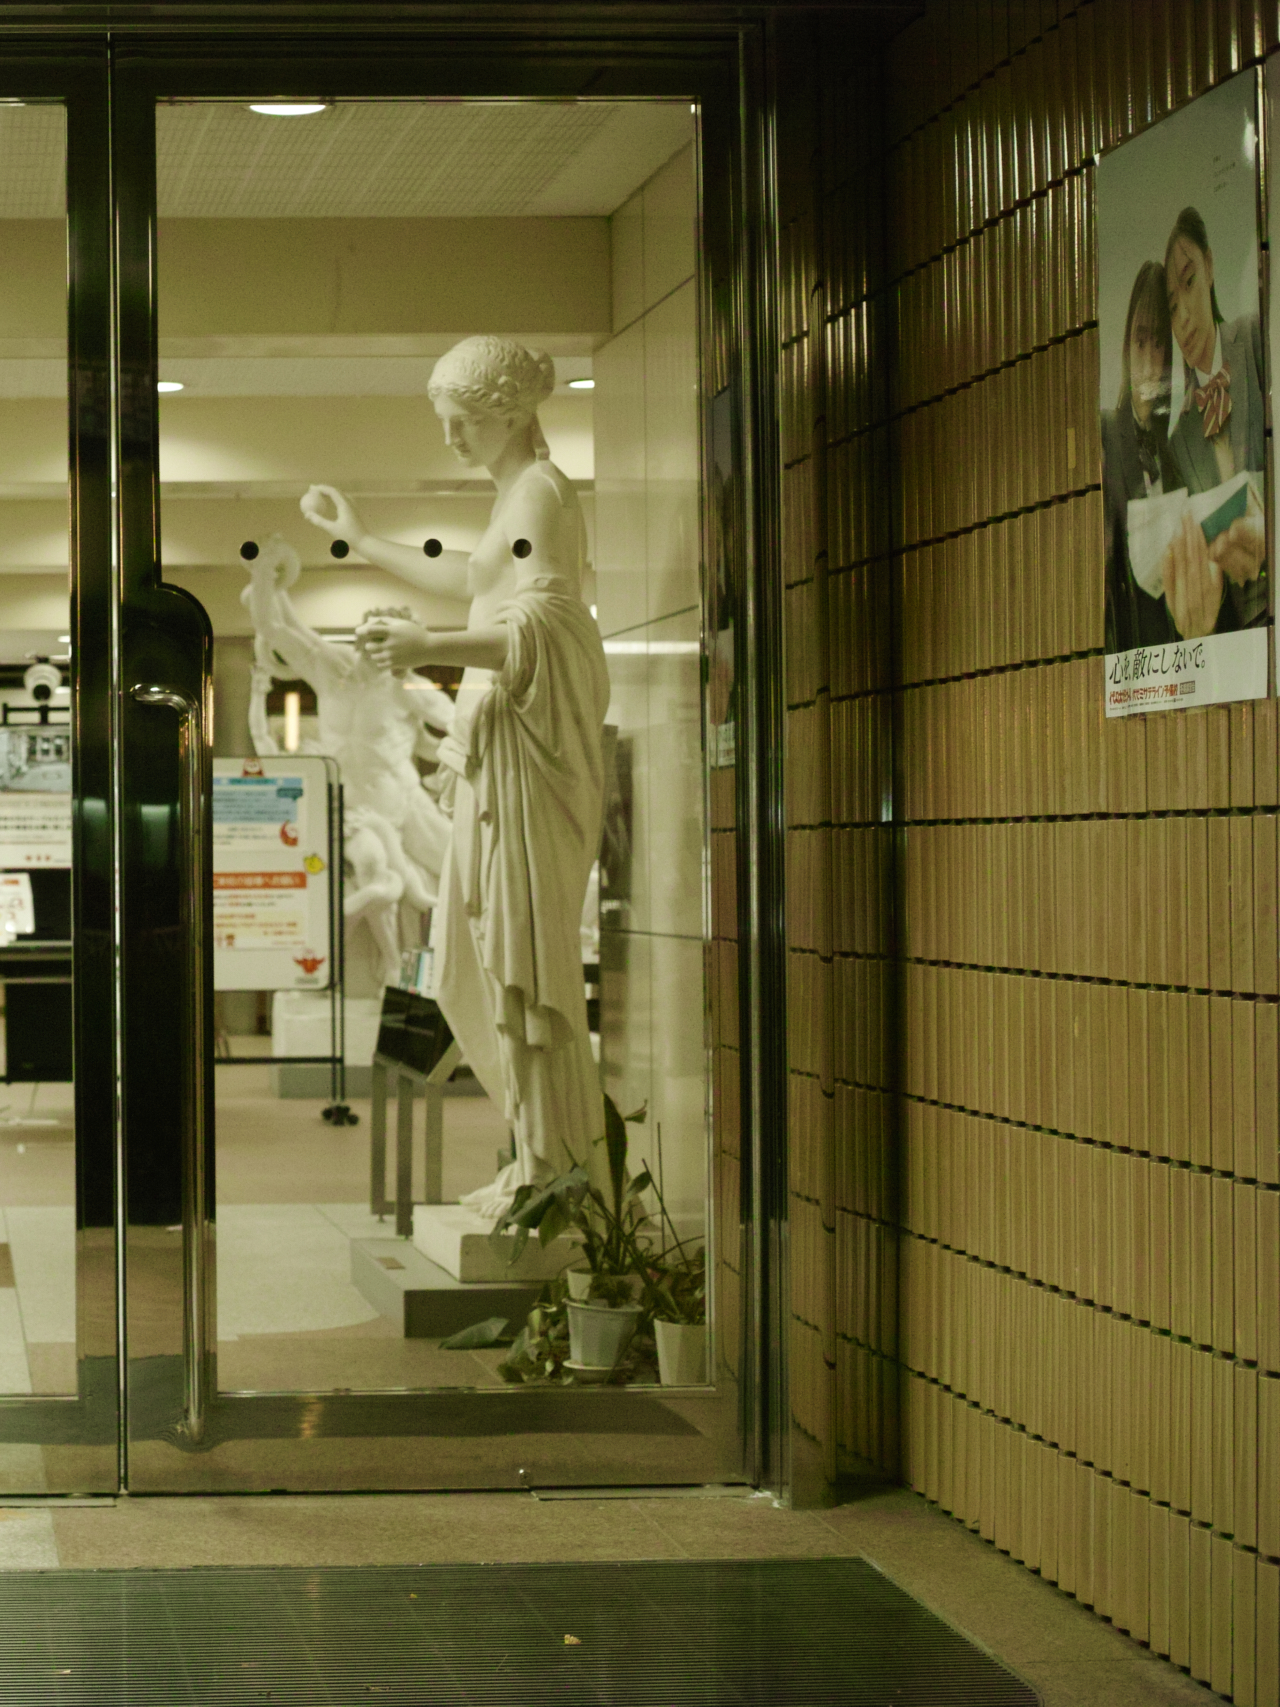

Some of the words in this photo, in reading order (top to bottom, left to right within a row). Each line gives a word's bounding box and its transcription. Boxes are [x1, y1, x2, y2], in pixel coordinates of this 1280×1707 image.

[1109, 643, 1206, 685] 心を、敵にしないで。
